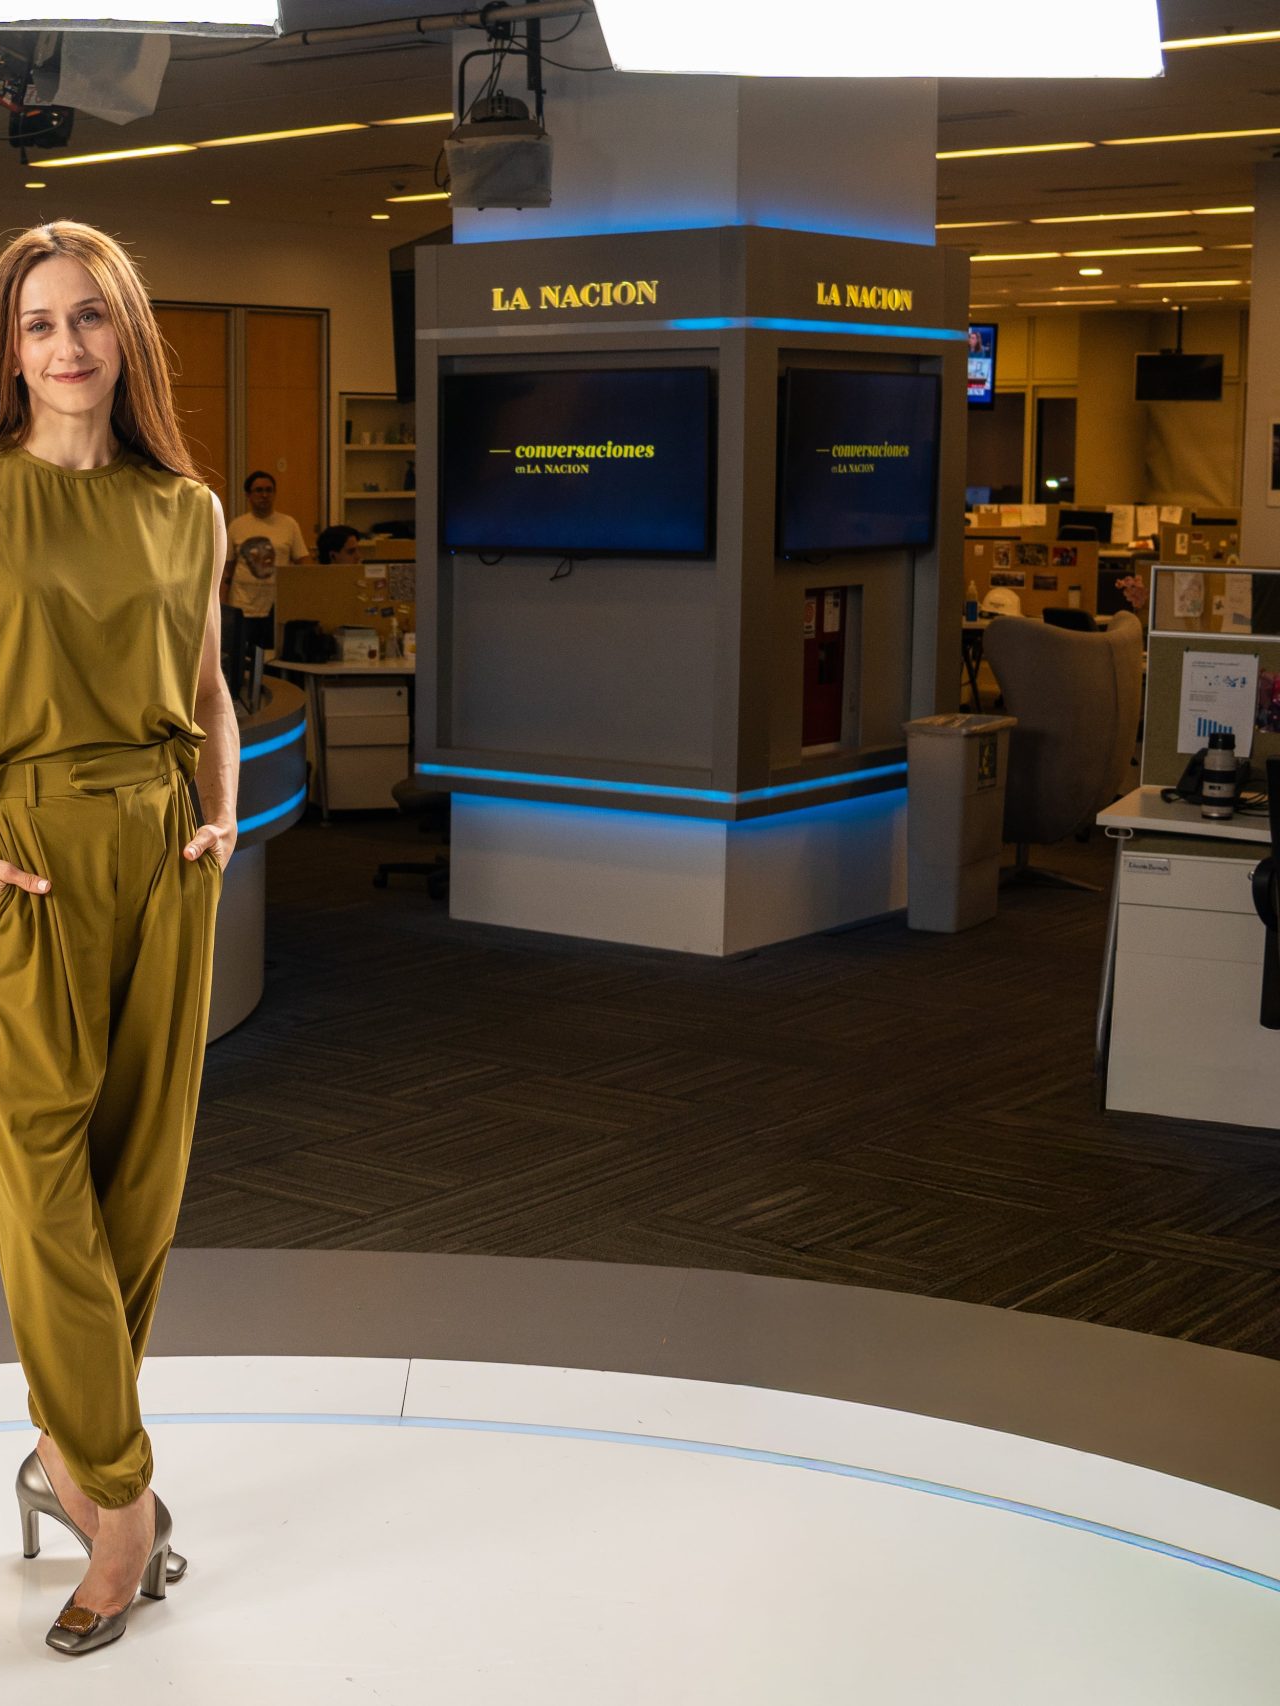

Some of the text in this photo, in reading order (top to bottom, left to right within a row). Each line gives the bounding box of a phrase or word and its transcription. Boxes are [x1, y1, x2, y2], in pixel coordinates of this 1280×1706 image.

[491, 280, 659, 311] LA NACION
[816, 282, 914, 312] LA NACION
[515, 440, 655, 459] conversaciones
[831, 440, 910, 458] conversaciones
[515, 464, 589, 475] en LA NACION
[838, 463, 847, 473] LA
[848, 463, 875, 473] NACION
